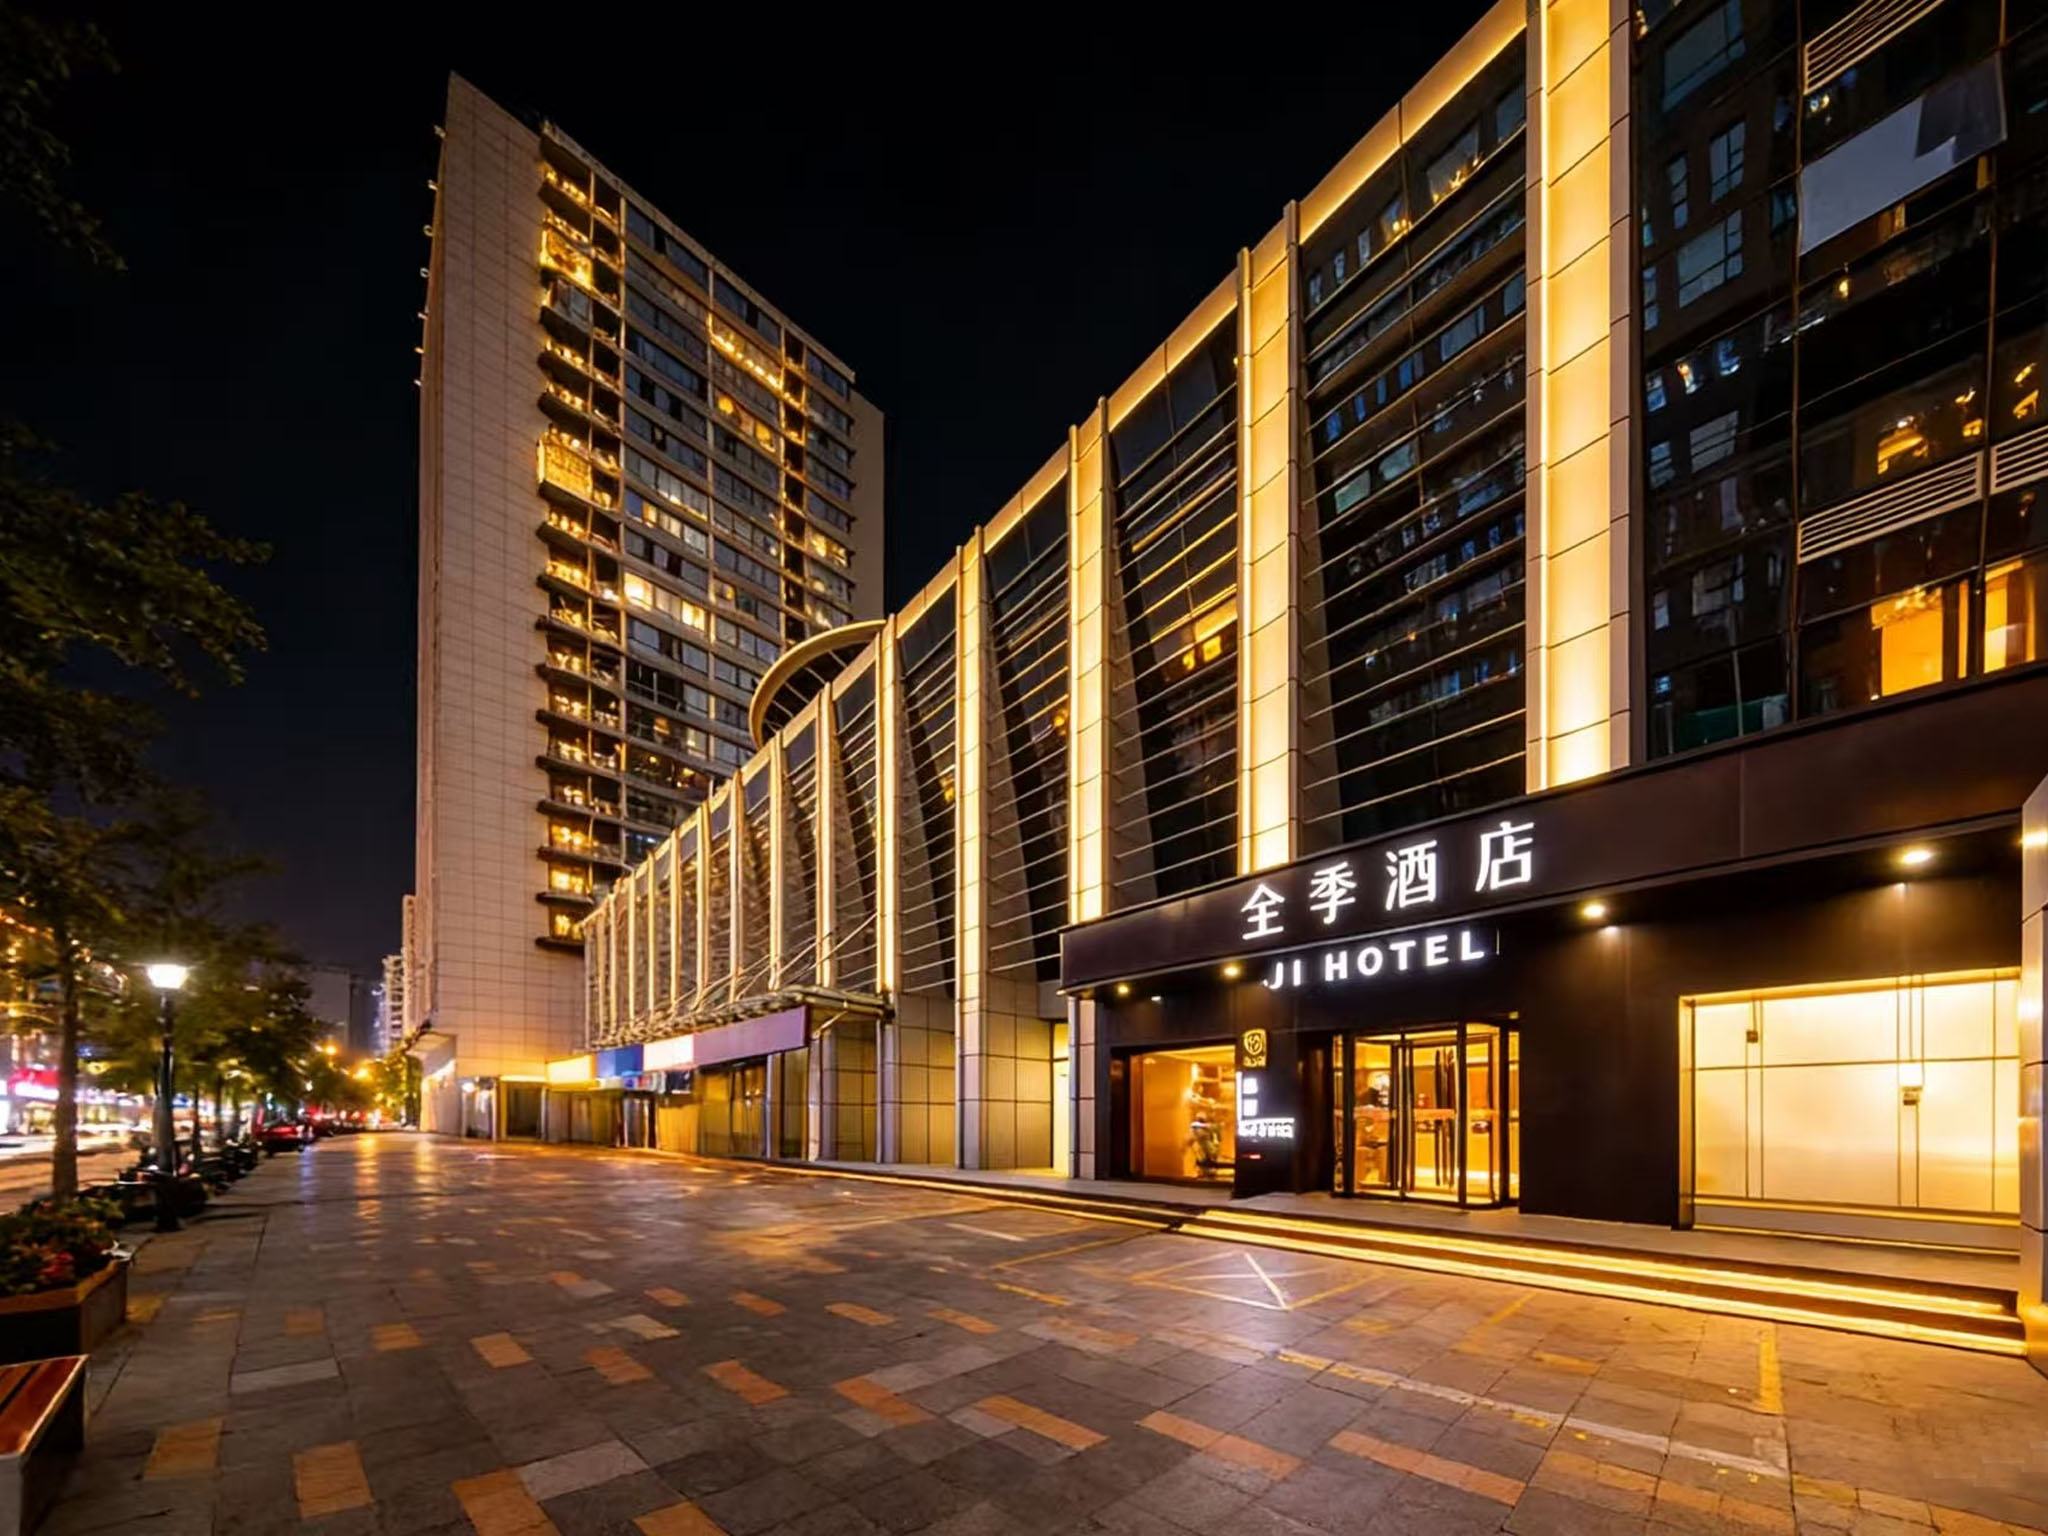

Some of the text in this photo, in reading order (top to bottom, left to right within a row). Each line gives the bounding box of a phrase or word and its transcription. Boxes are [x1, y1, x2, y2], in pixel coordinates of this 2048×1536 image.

[1241, 821, 1535, 940] 全季酒店
[1263, 930, 1485, 990] JI HOTEL
